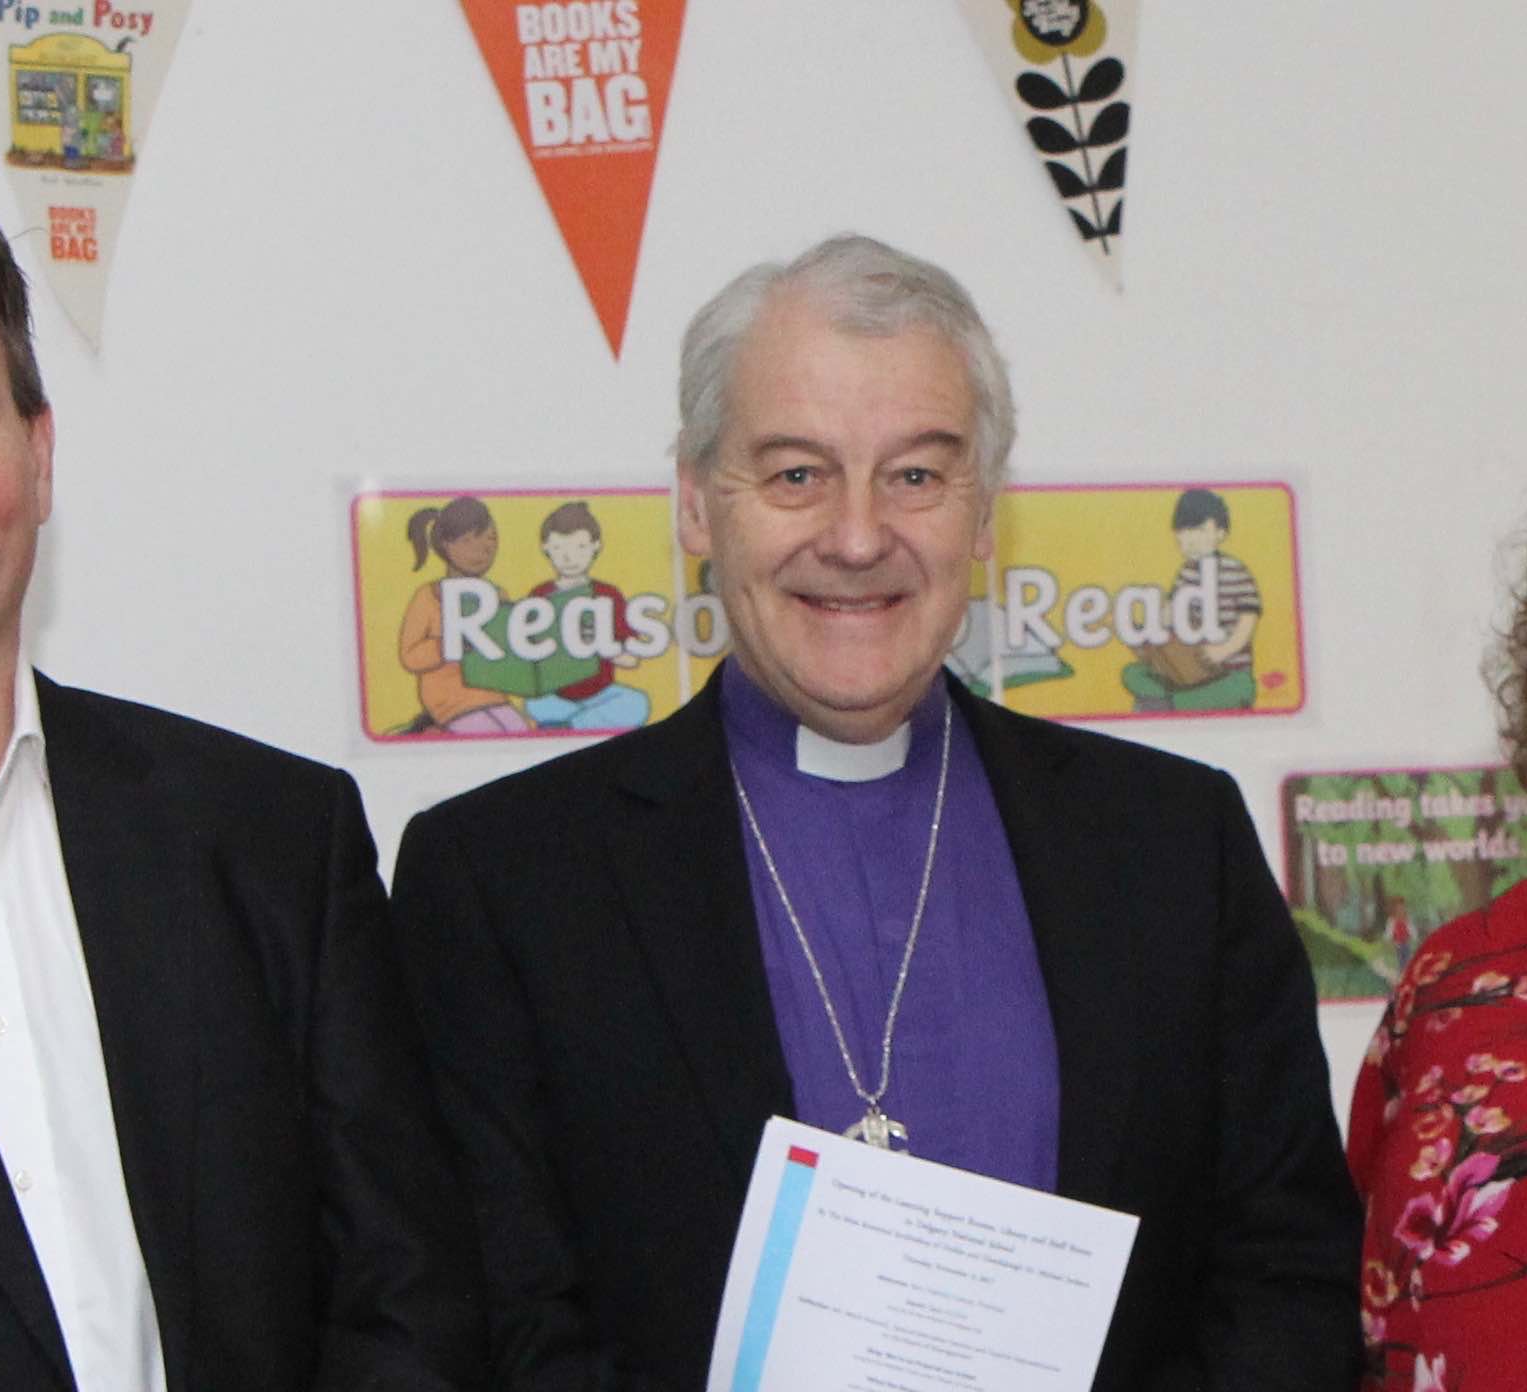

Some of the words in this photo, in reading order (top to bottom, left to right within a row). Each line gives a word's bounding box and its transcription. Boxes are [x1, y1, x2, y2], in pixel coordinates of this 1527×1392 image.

[49, 7, 84, 26] and
[92, 0, 154, 35] Posy
[516, 0, 642, 43] BOOKS
[524, 43, 584, 80] ARE
[588, 38, 642, 74] MY
[526, 74, 651, 147] BAG
[51, 237, 99, 262] BAG
[441, 576, 730, 660] Reaso
[1004, 554, 1229, 649] Read
[1295, 790, 1412, 827] Reading
[1420, 789, 1495, 817] takes
[1317, 839, 1349, 866] to
[1355, 842, 1417, 865] new
